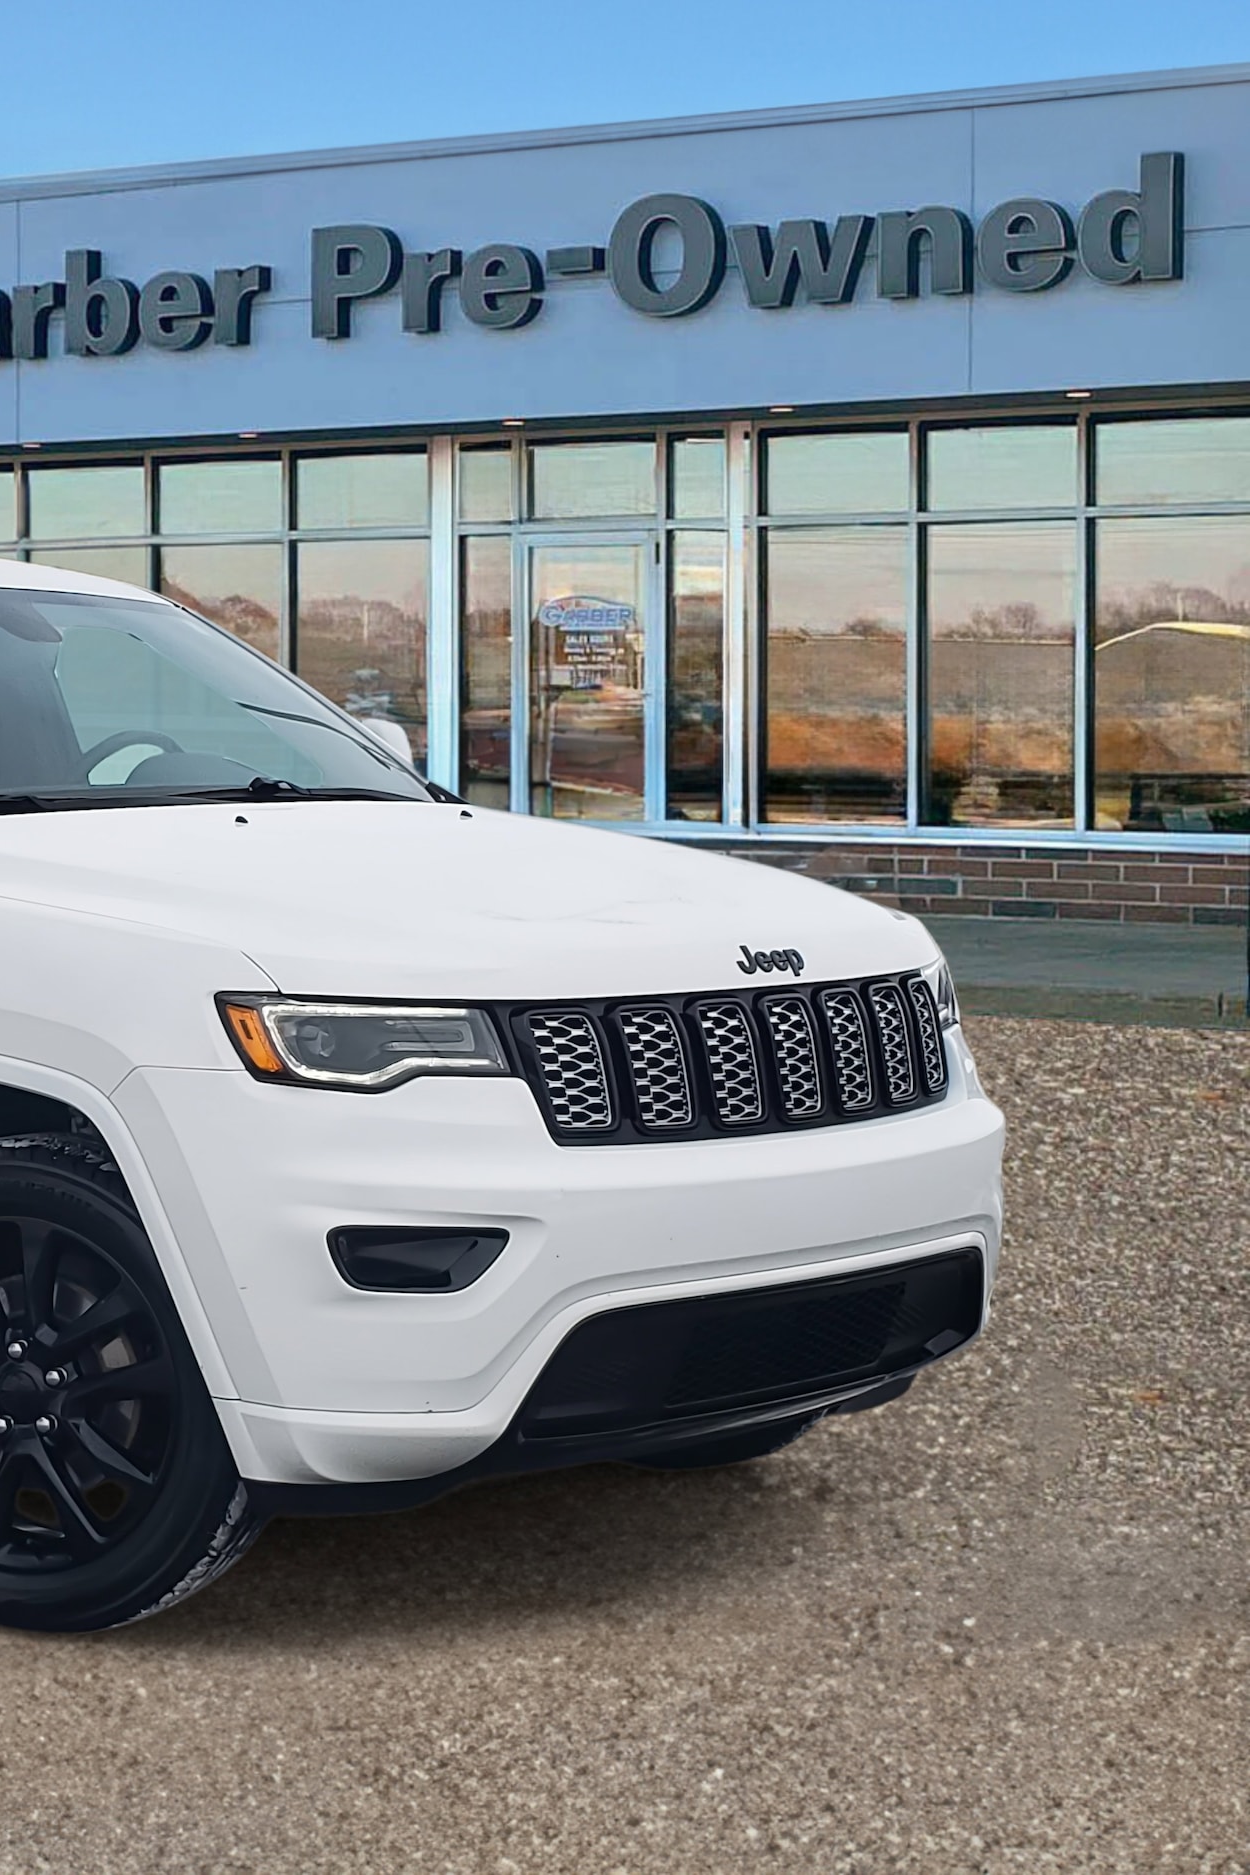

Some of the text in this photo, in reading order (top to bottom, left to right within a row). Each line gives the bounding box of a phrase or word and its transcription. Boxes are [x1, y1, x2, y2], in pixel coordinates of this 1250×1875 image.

[311, 151, 1186, 340] Pre-Owned
[541, 606, 632, 627] GARBER
[736, 945, 804, 976] Jeep
